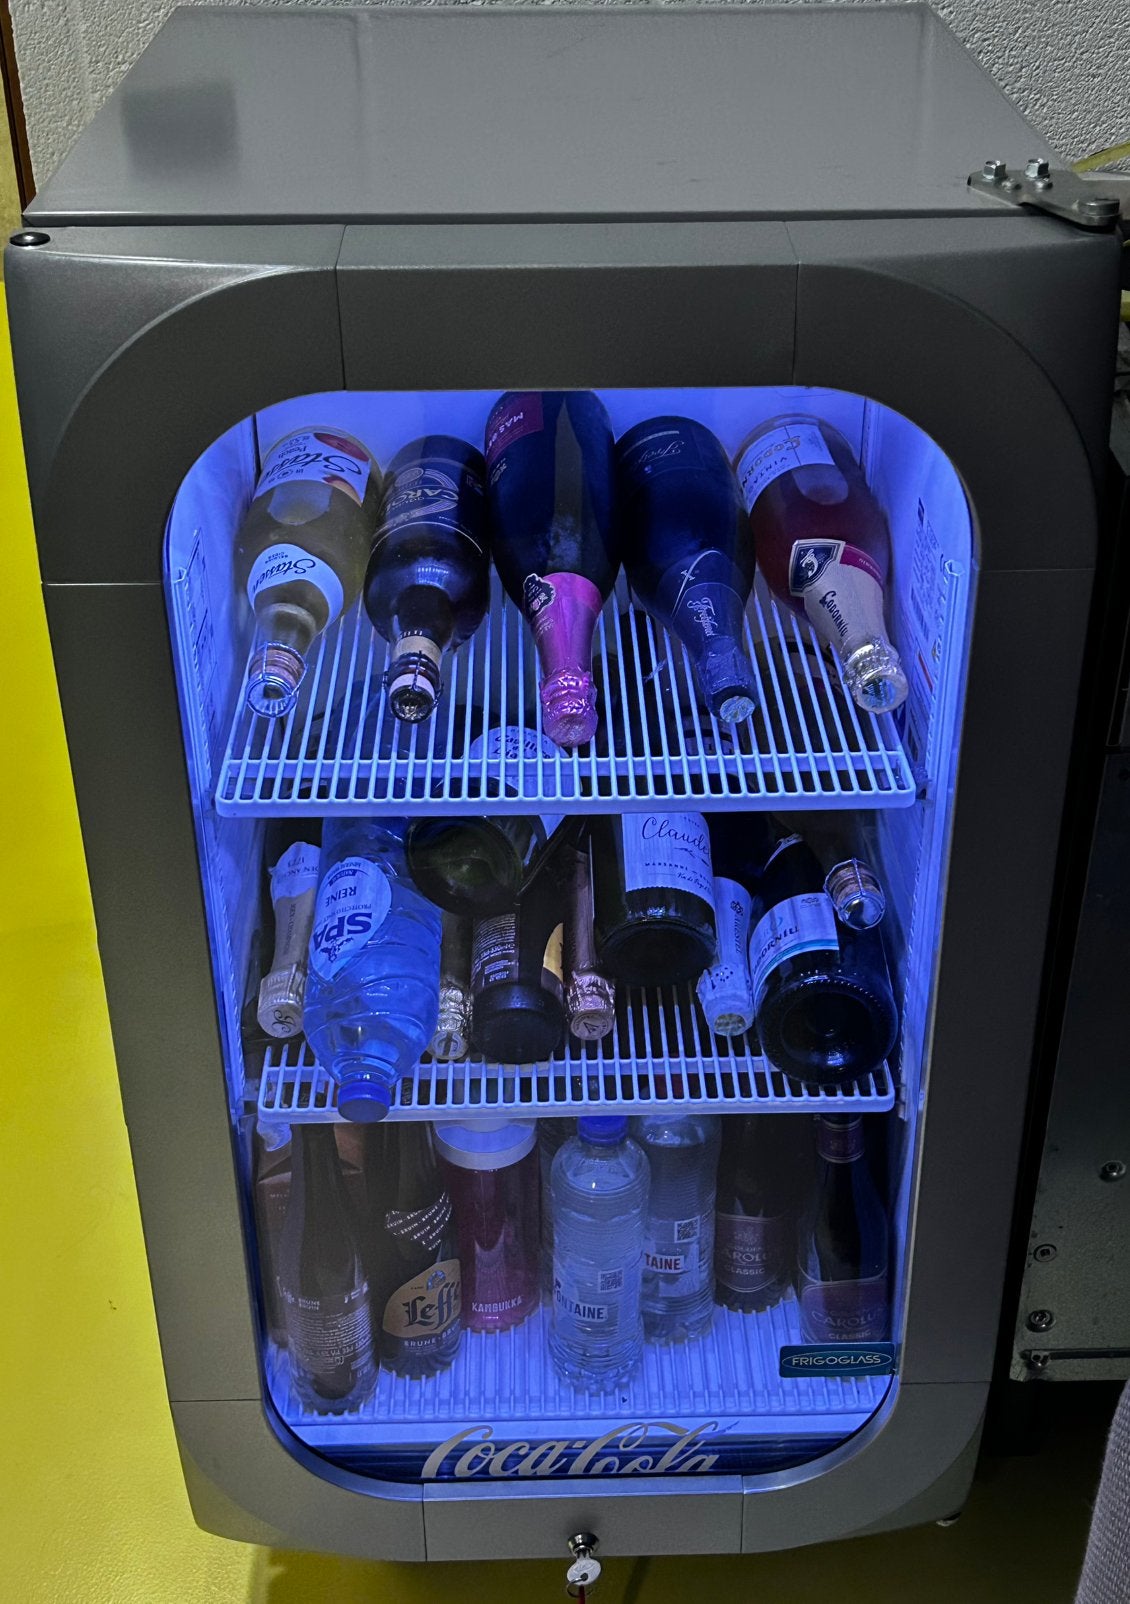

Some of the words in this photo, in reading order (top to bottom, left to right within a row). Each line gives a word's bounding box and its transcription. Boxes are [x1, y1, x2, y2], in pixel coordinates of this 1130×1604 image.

[324, 886, 358, 908] REINE
[312, 912, 373, 950] SPA
[791, 1353, 882, 1367] FRIGOGLASS
[421, 1420, 720, 1479] Coca-Cola
